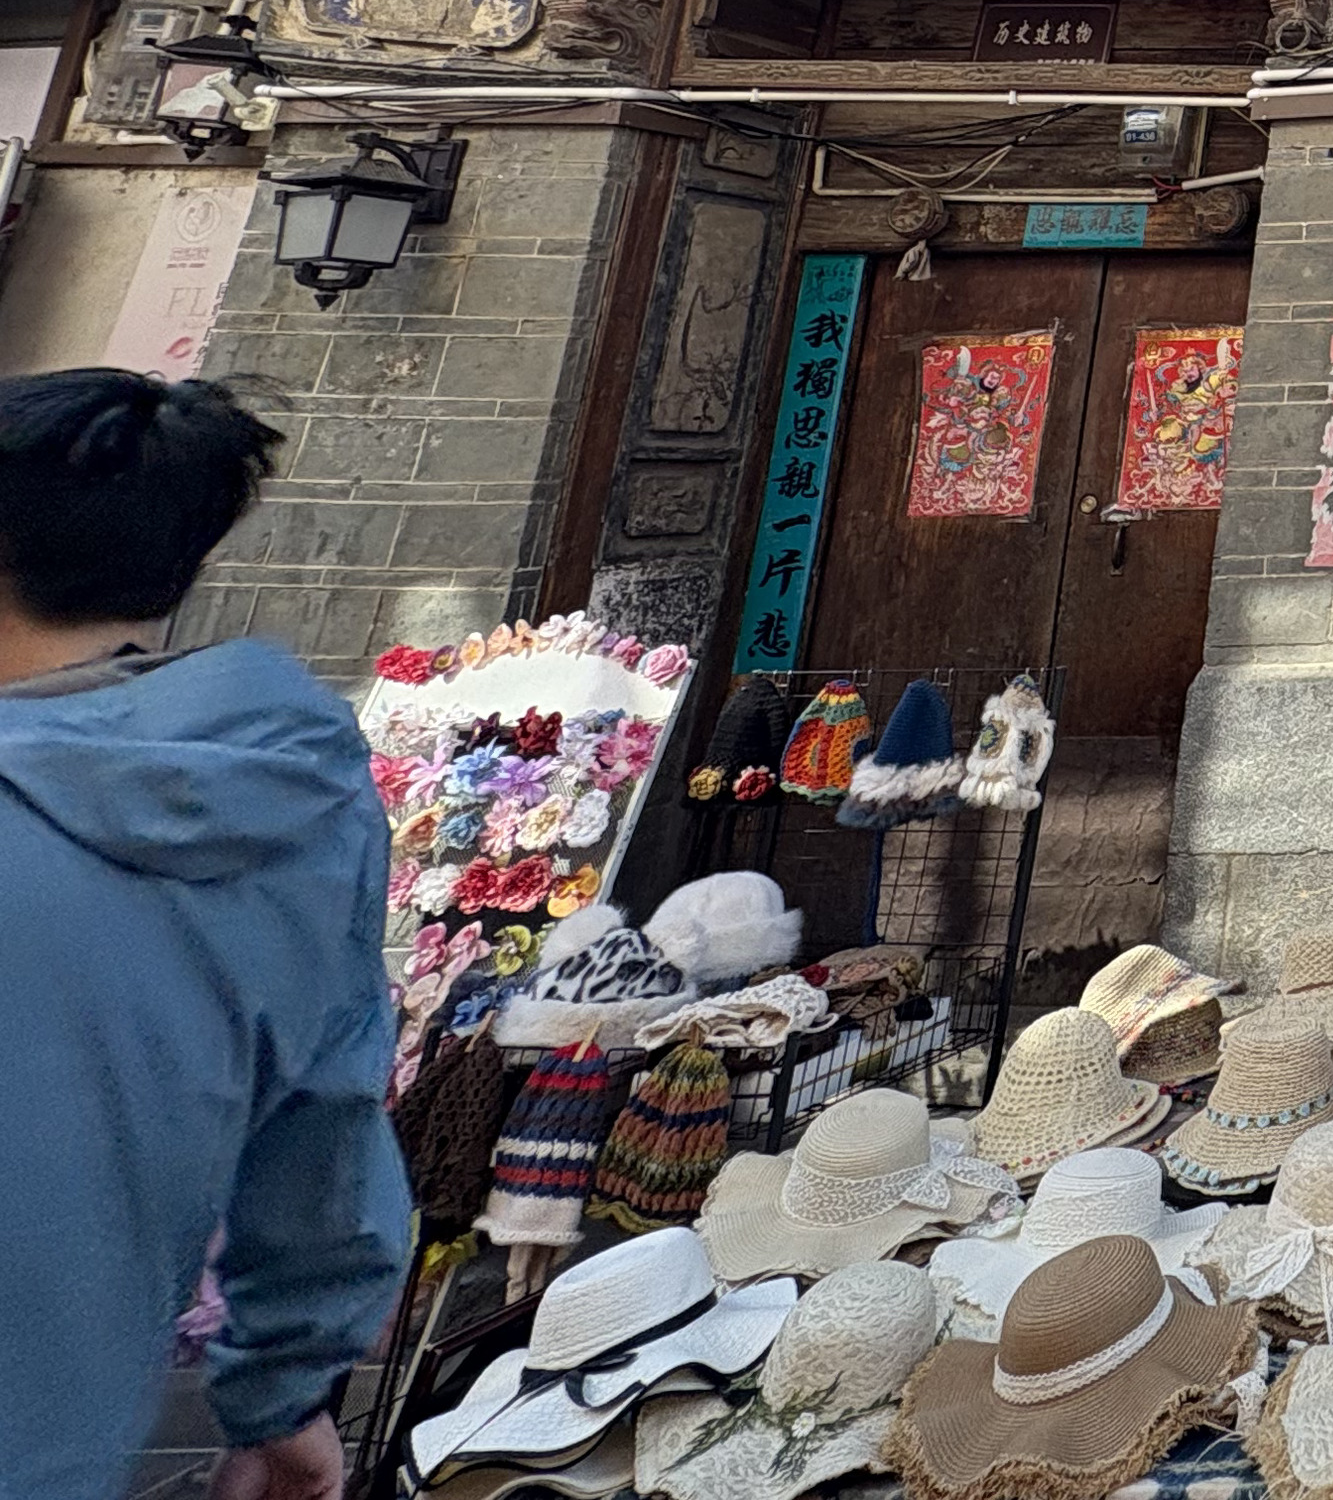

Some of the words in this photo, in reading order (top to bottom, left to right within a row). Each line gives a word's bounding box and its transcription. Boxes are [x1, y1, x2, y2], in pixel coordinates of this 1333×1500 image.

[993, 19, 1093, 45] 历史建筑物
[748, 309, 849, 659] 我獨思親一片悲
